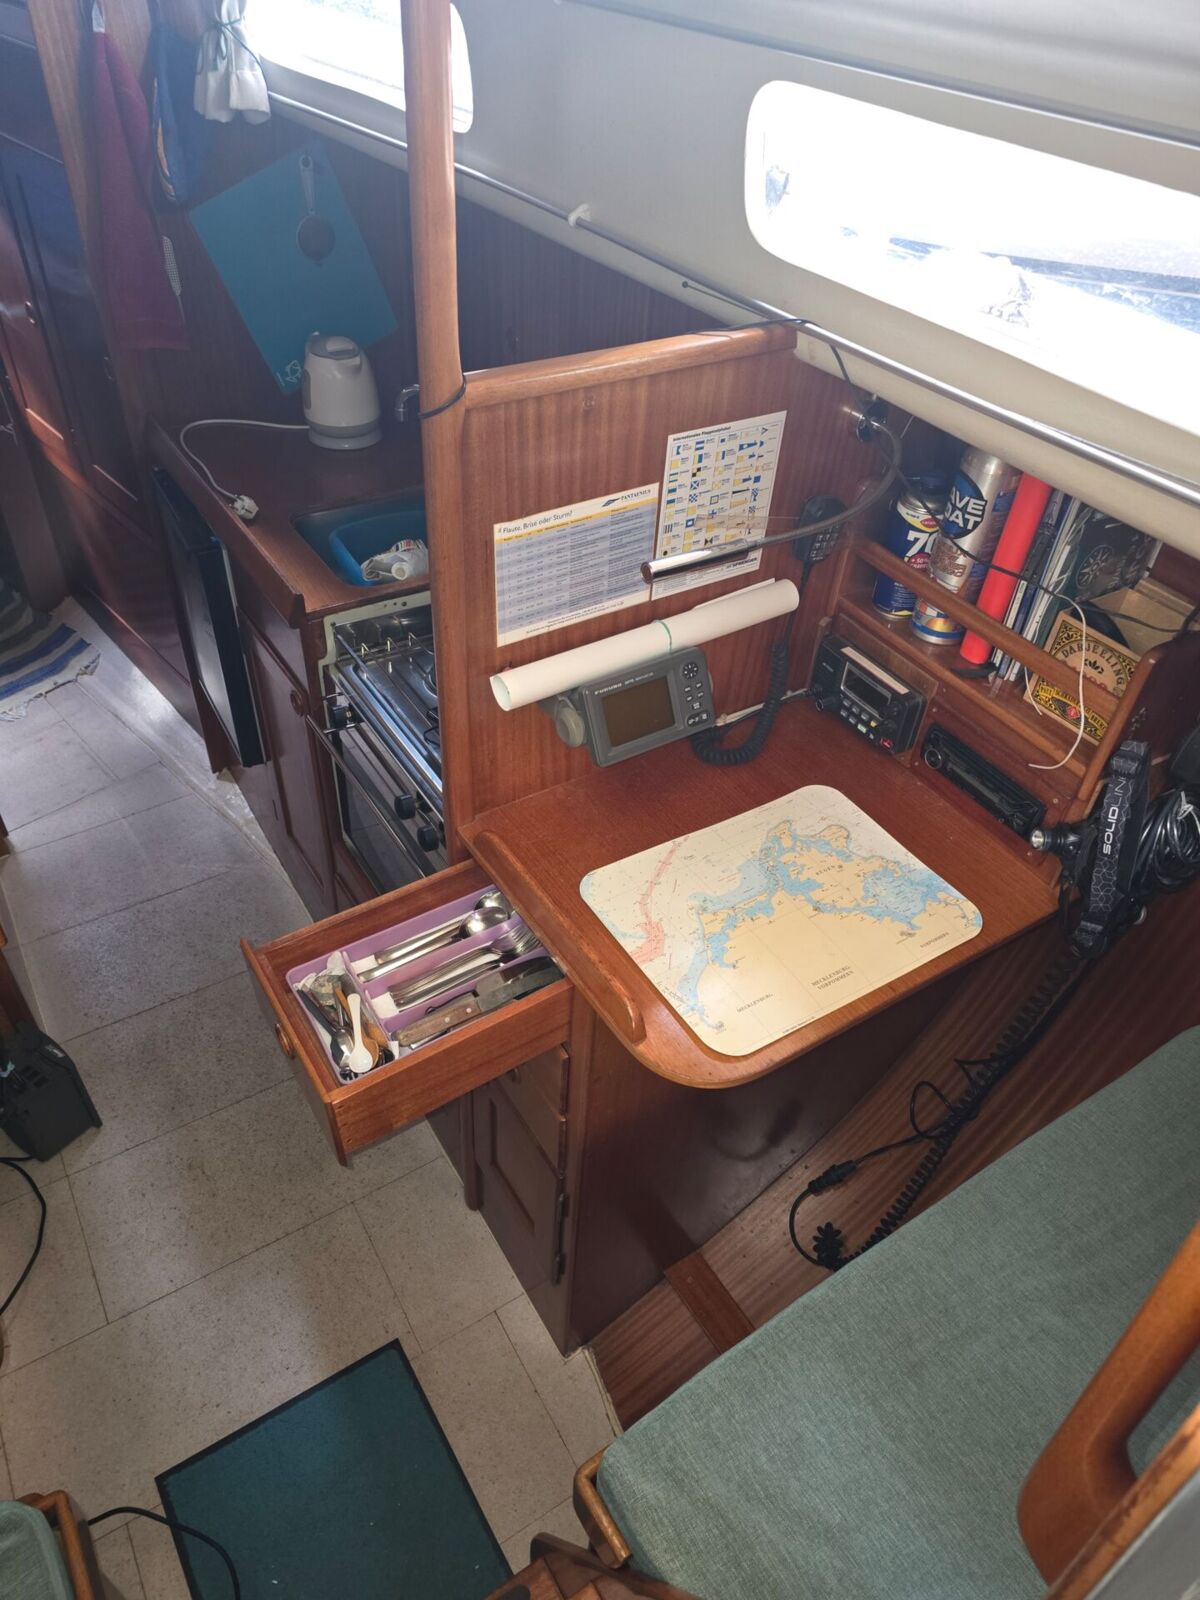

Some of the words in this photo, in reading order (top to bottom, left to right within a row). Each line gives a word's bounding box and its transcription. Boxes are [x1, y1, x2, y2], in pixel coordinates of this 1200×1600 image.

[620, 488, 652, 501] PANTAENIUS
[950, 487, 986, 515] AVE
[502, 524, 522, 534] Flaute,
[523, 520, 538, 531] Brise
[538, 517, 552, 526] oder
[552, 510, 573, 521] Sturm?
[944, 501, 982, 531] OAT
[1061, 642, 1124, 685] DARJEELING
[594, 682, 622, 695] FURUNO
